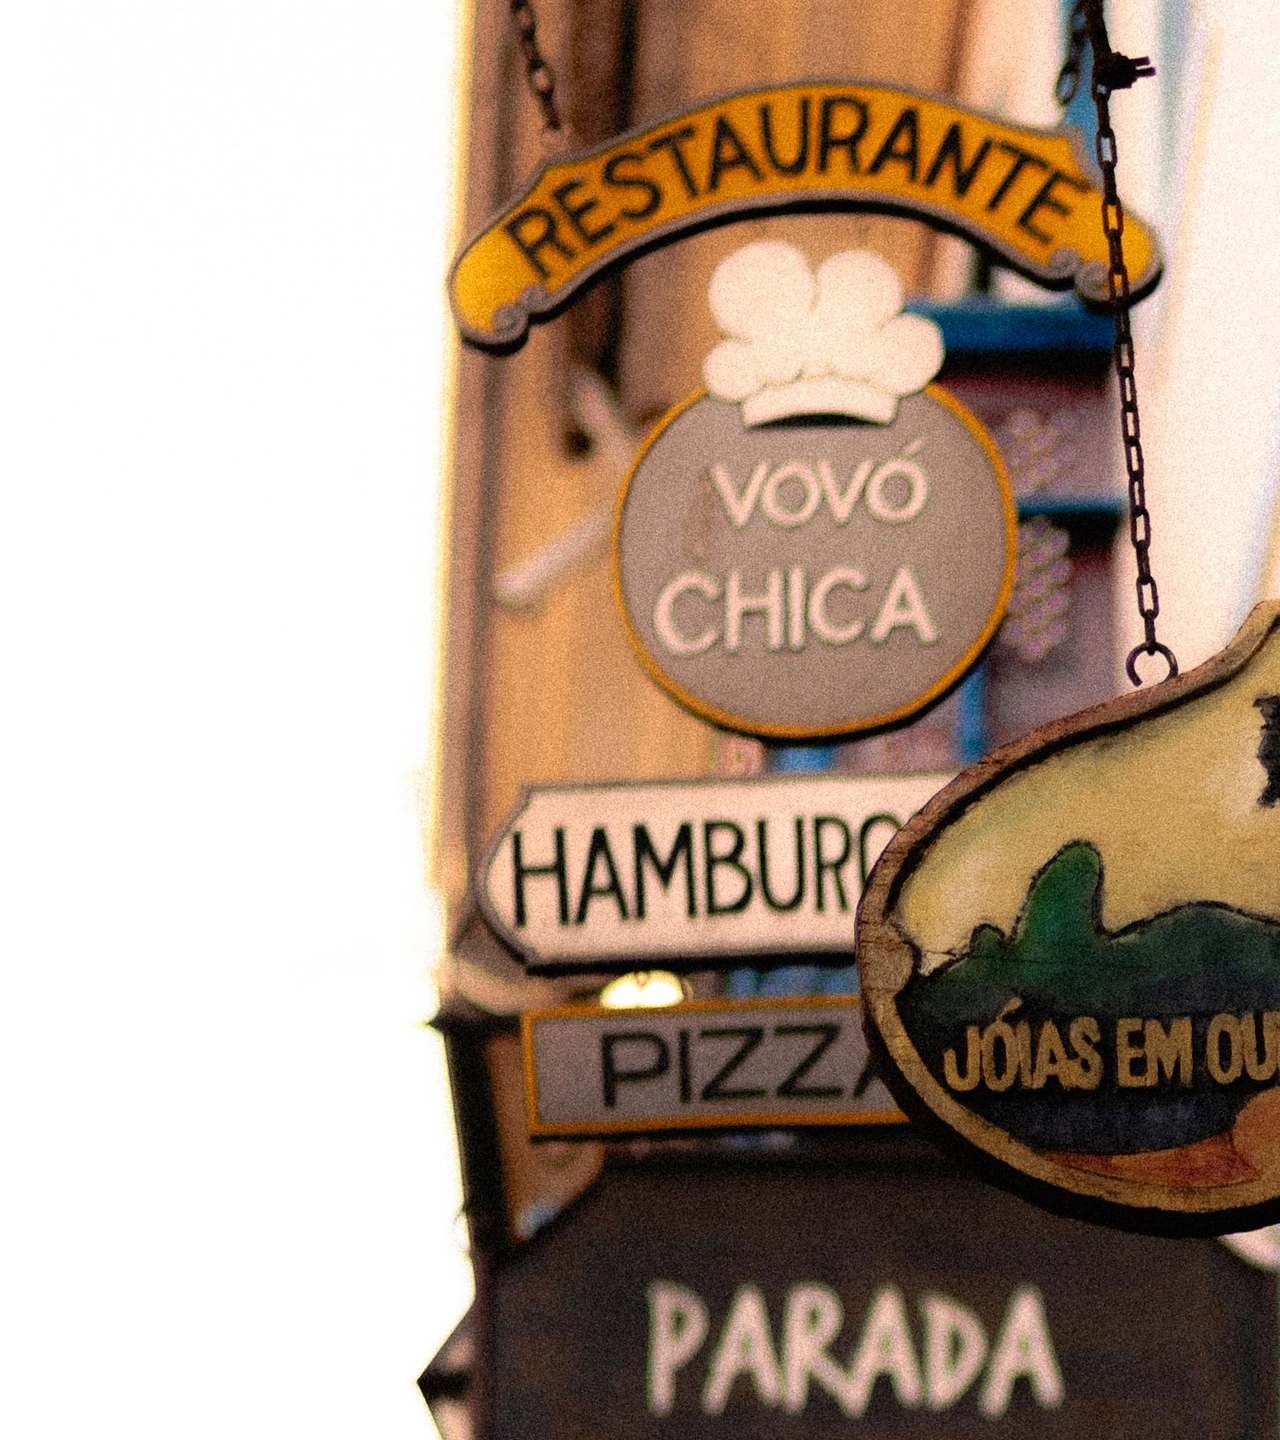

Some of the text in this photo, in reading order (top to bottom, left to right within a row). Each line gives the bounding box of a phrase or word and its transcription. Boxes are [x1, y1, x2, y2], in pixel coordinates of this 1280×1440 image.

[503, 94, 1098, 280] RESTAURANTE
[711, 439, 927, 528] VOVÓ
[654, 566, 938, 656] CHICA
[942, 996, 1101, 1092] JÓIAS
[1116, 1015, 1194, 1088] EM
[646, 1278, 1066, 1419] PARADA
